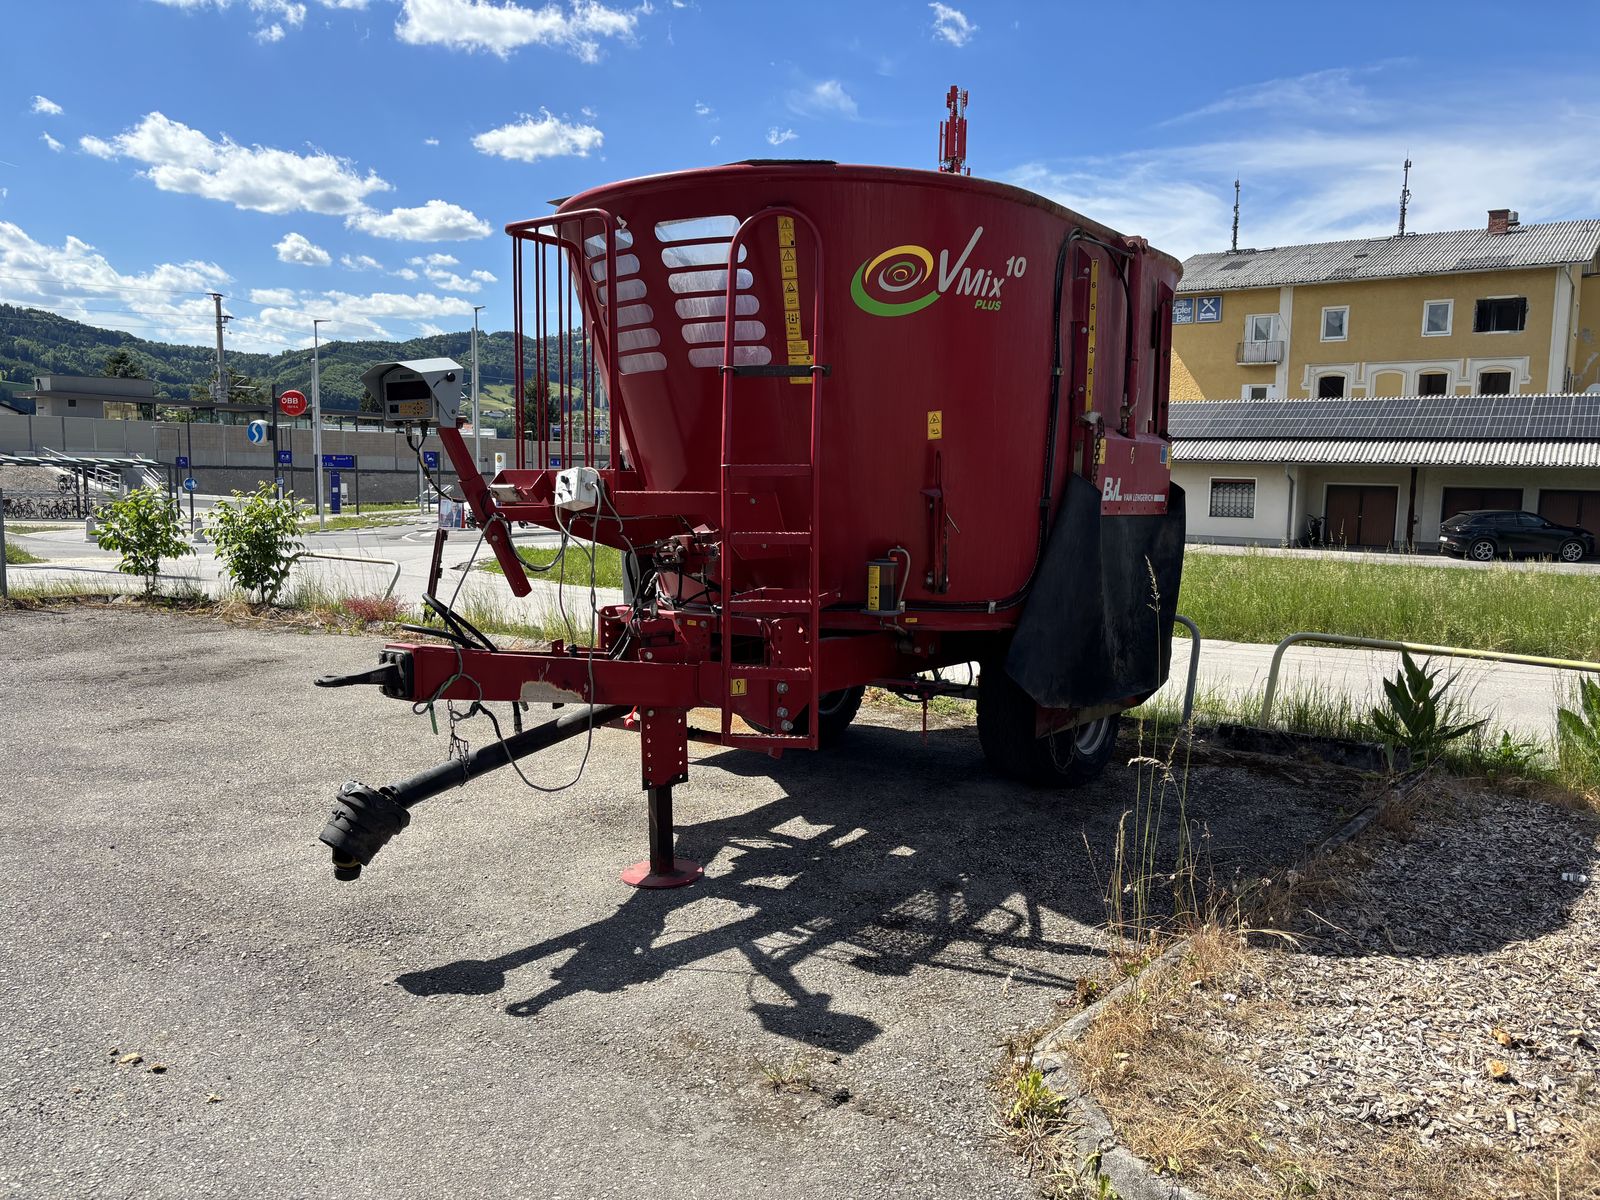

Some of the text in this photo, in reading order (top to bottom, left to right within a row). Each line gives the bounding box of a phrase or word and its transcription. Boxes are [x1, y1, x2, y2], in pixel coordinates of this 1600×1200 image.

[1006, 256, 1027, 278] 10
[974, 299, 1002, 311] PLUS
[1176, 312, 1191, 323] Bier
